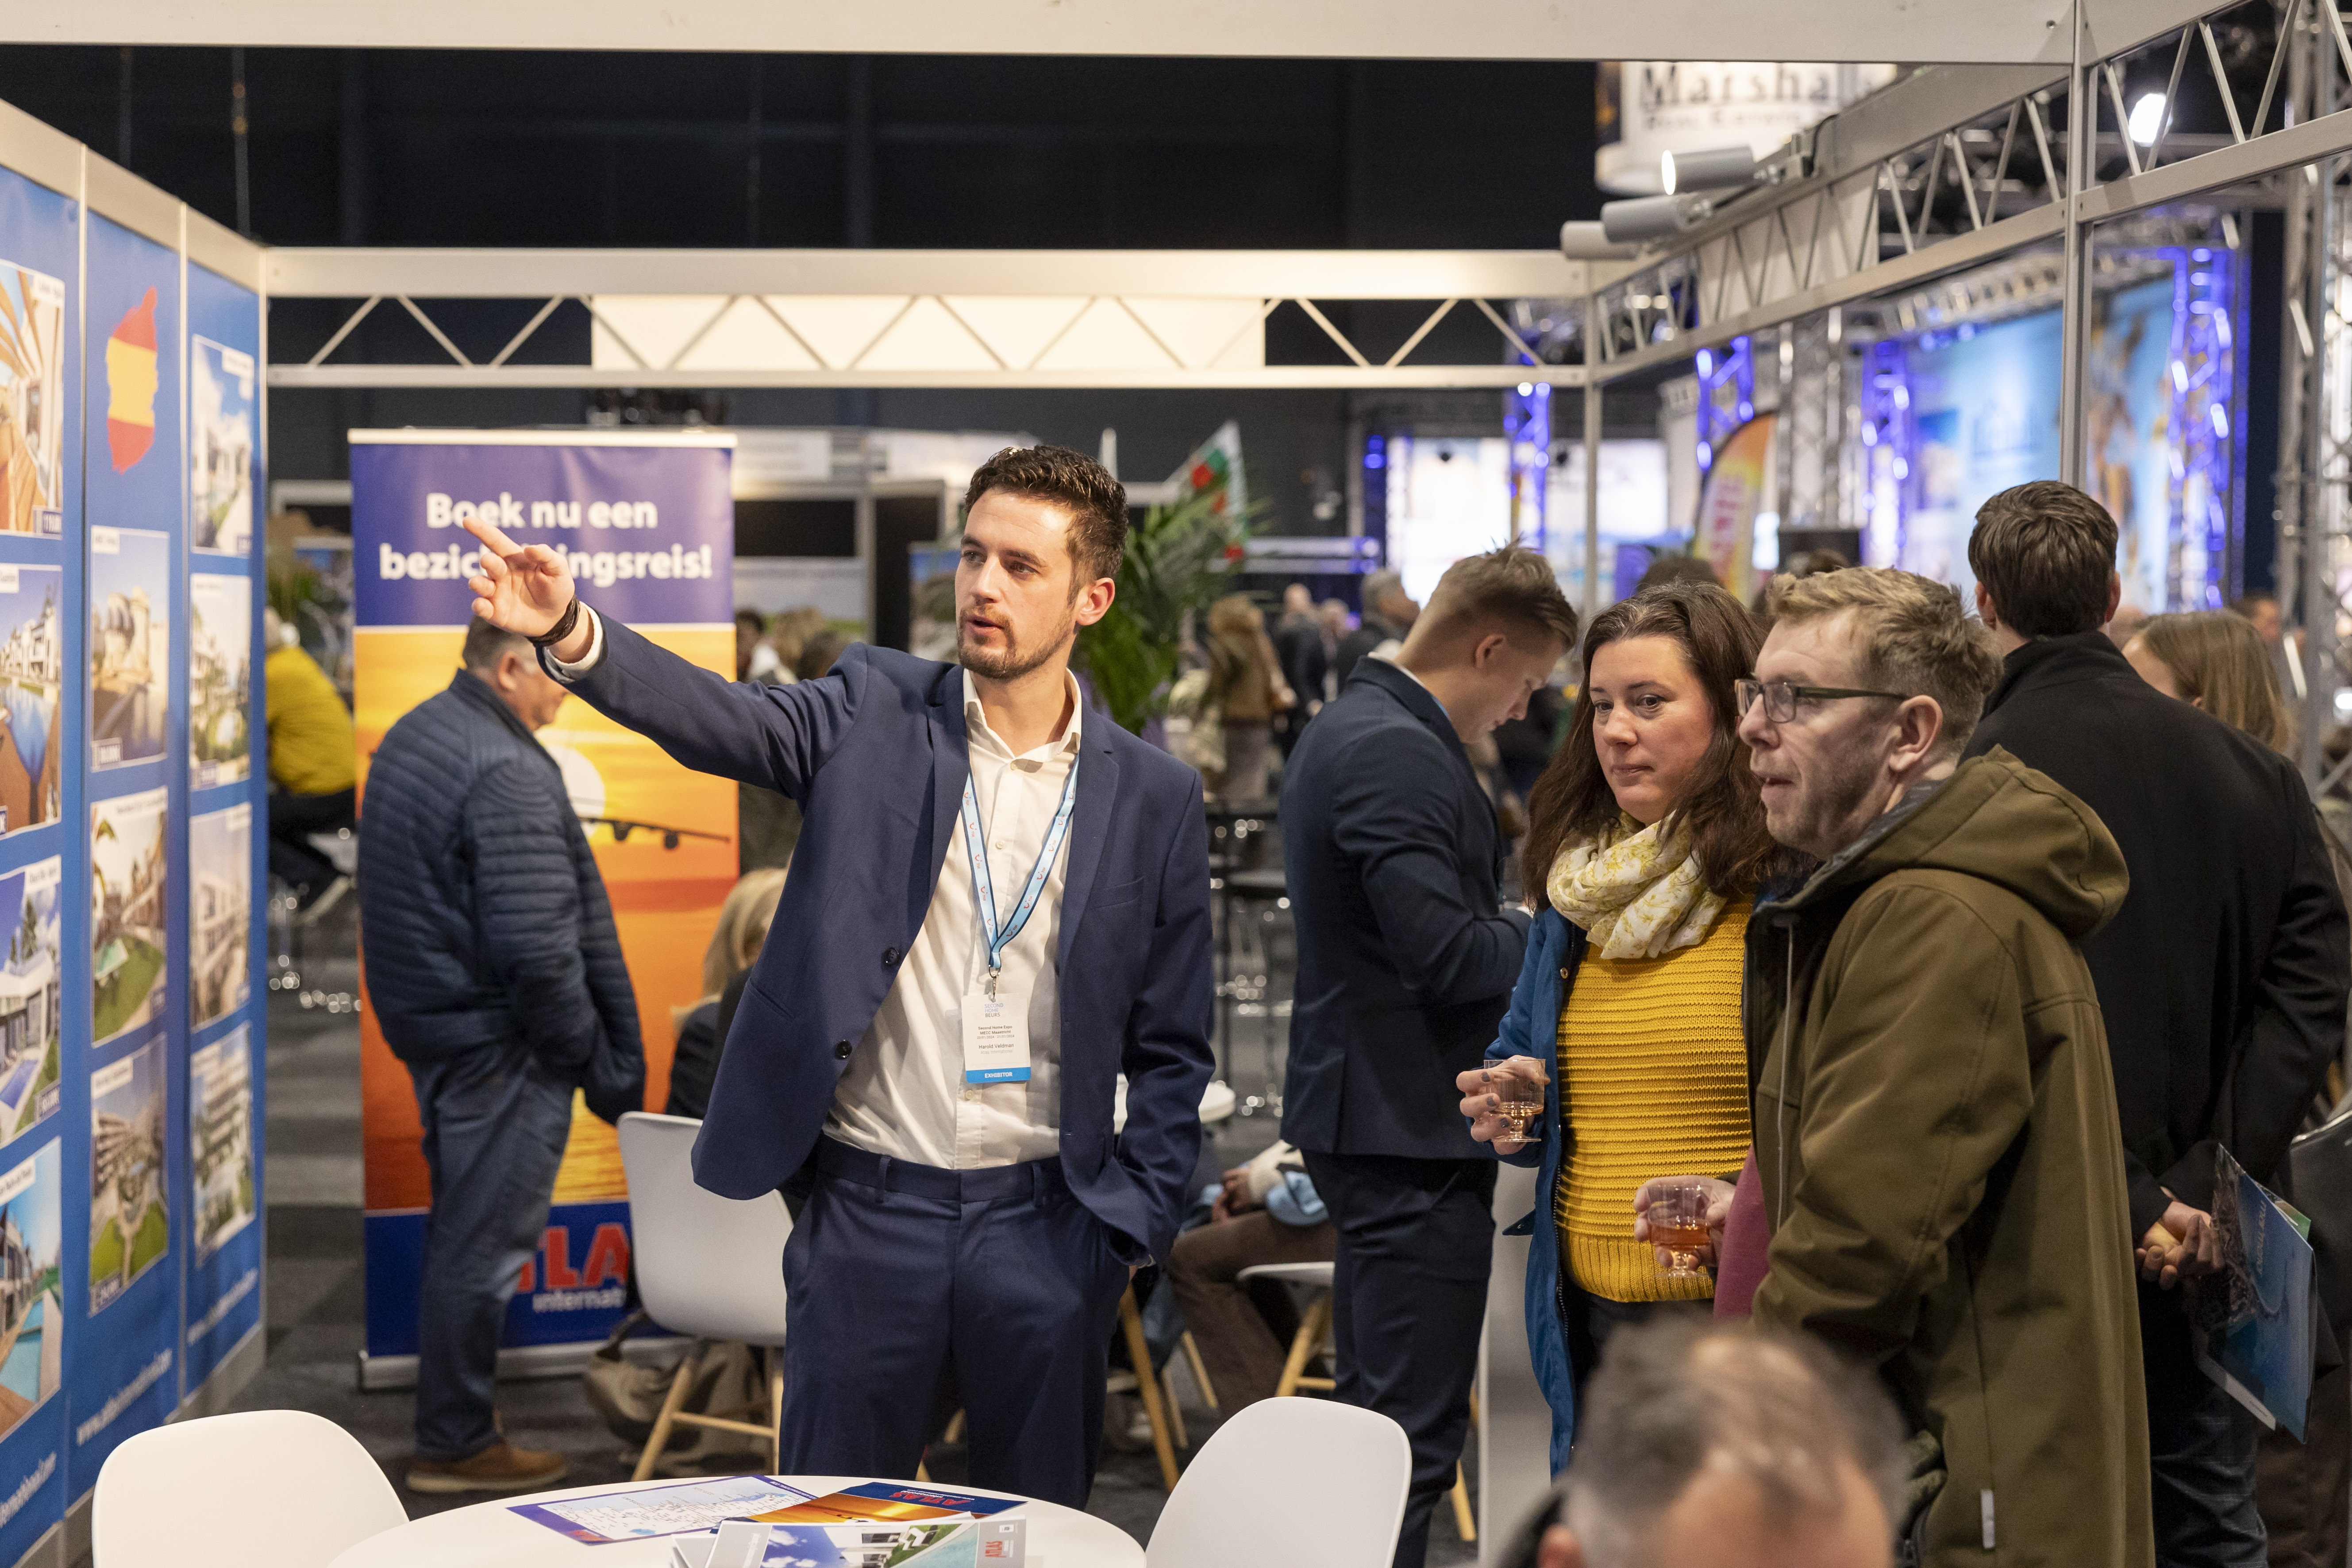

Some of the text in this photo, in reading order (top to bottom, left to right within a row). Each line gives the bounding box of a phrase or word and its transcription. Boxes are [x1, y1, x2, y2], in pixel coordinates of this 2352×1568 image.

[426, 491, 658, 529] Boek nu een
[379, 543, 713, 588] bezicngsreis!
[889, 1492, 971, 1505] ATLAS
